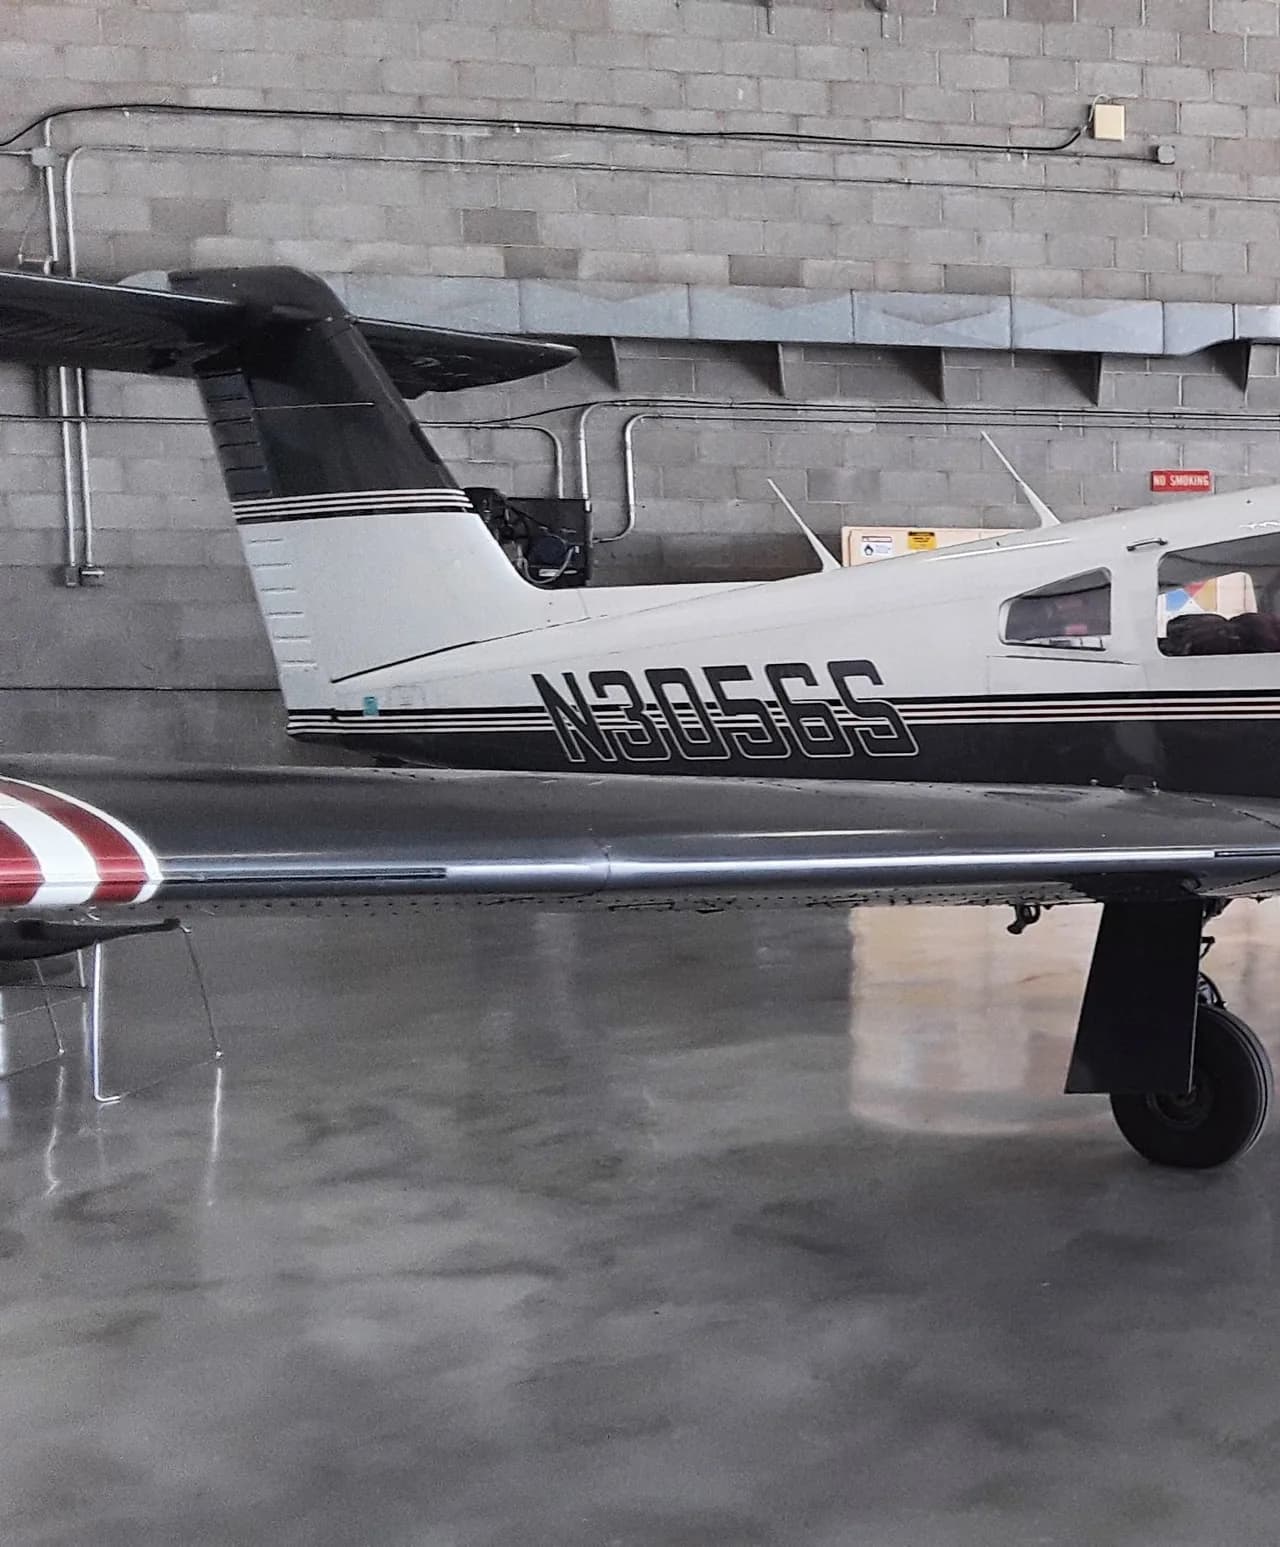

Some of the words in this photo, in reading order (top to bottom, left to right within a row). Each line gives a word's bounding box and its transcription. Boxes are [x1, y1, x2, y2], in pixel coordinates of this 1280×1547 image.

[1153, 474, 1166, 486] NO
[1169, 474, 1209, 487] SMOKING
[530, 659, 919, 762] N3056S
